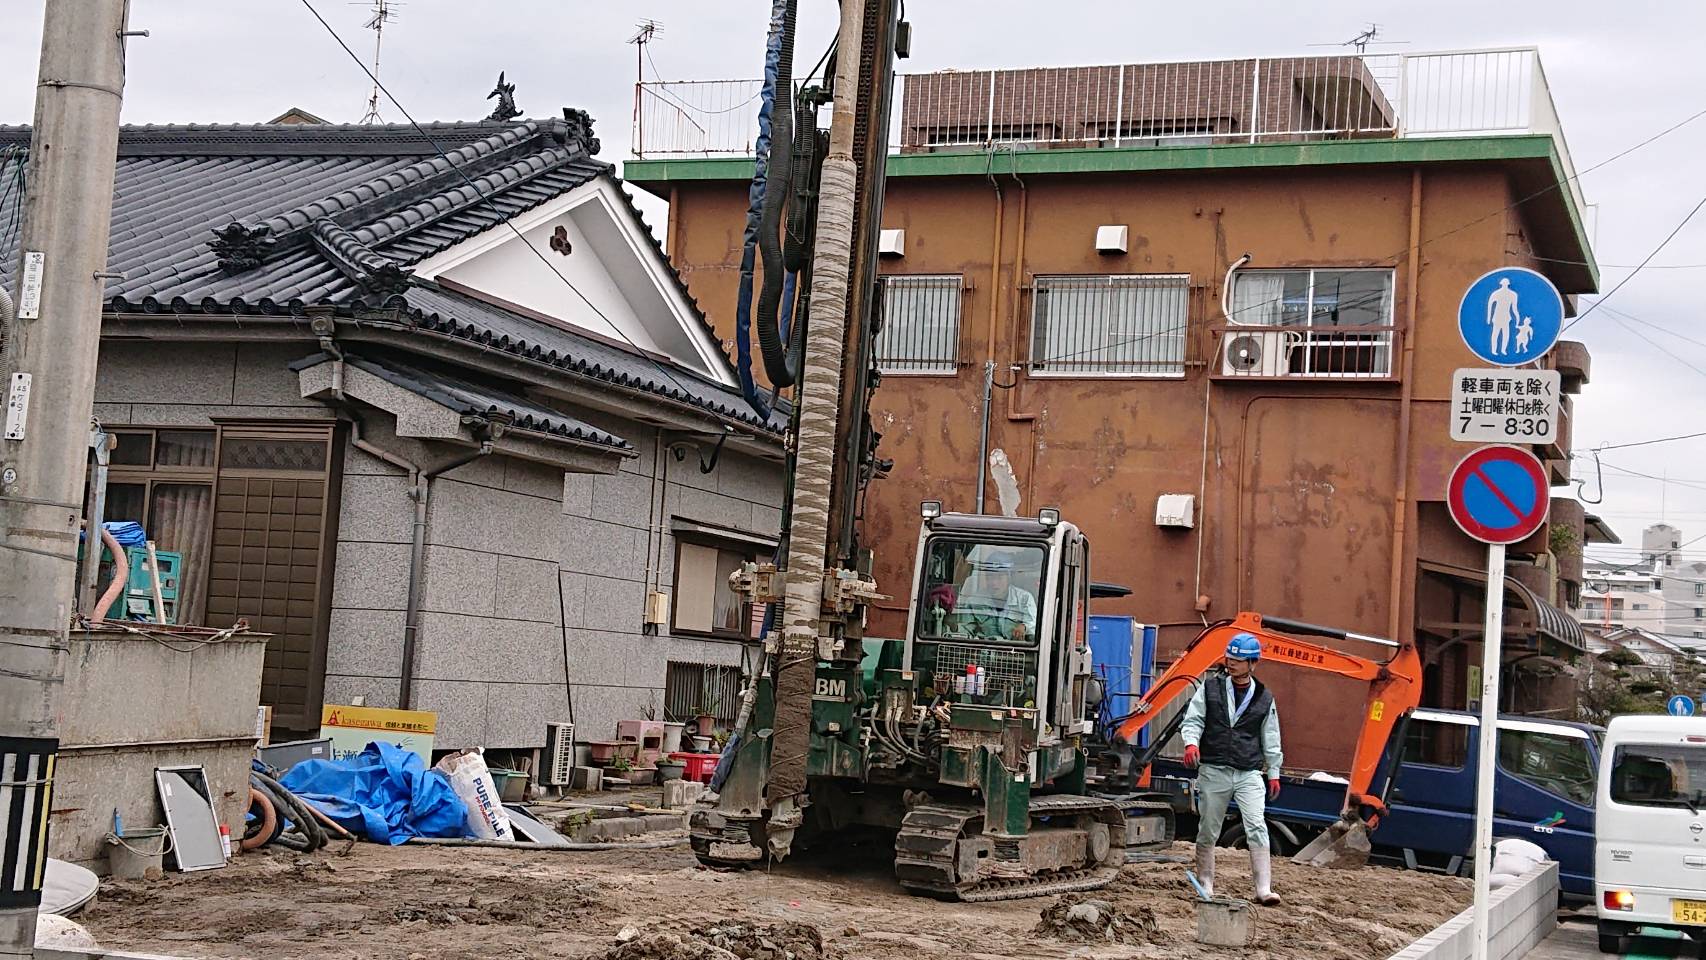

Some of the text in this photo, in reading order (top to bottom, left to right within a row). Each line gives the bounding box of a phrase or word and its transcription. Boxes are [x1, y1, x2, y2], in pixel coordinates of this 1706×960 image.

[1461, 377, 1551, 396] 軽車両を除く
[1460, 397, 1550, 416] 土曜日曜休日を除く
[1459, 416, 1472, 434] 7
[1504, 418, 1550, 436] 8:30
[473, 777, 506, 838] PURE PILE
